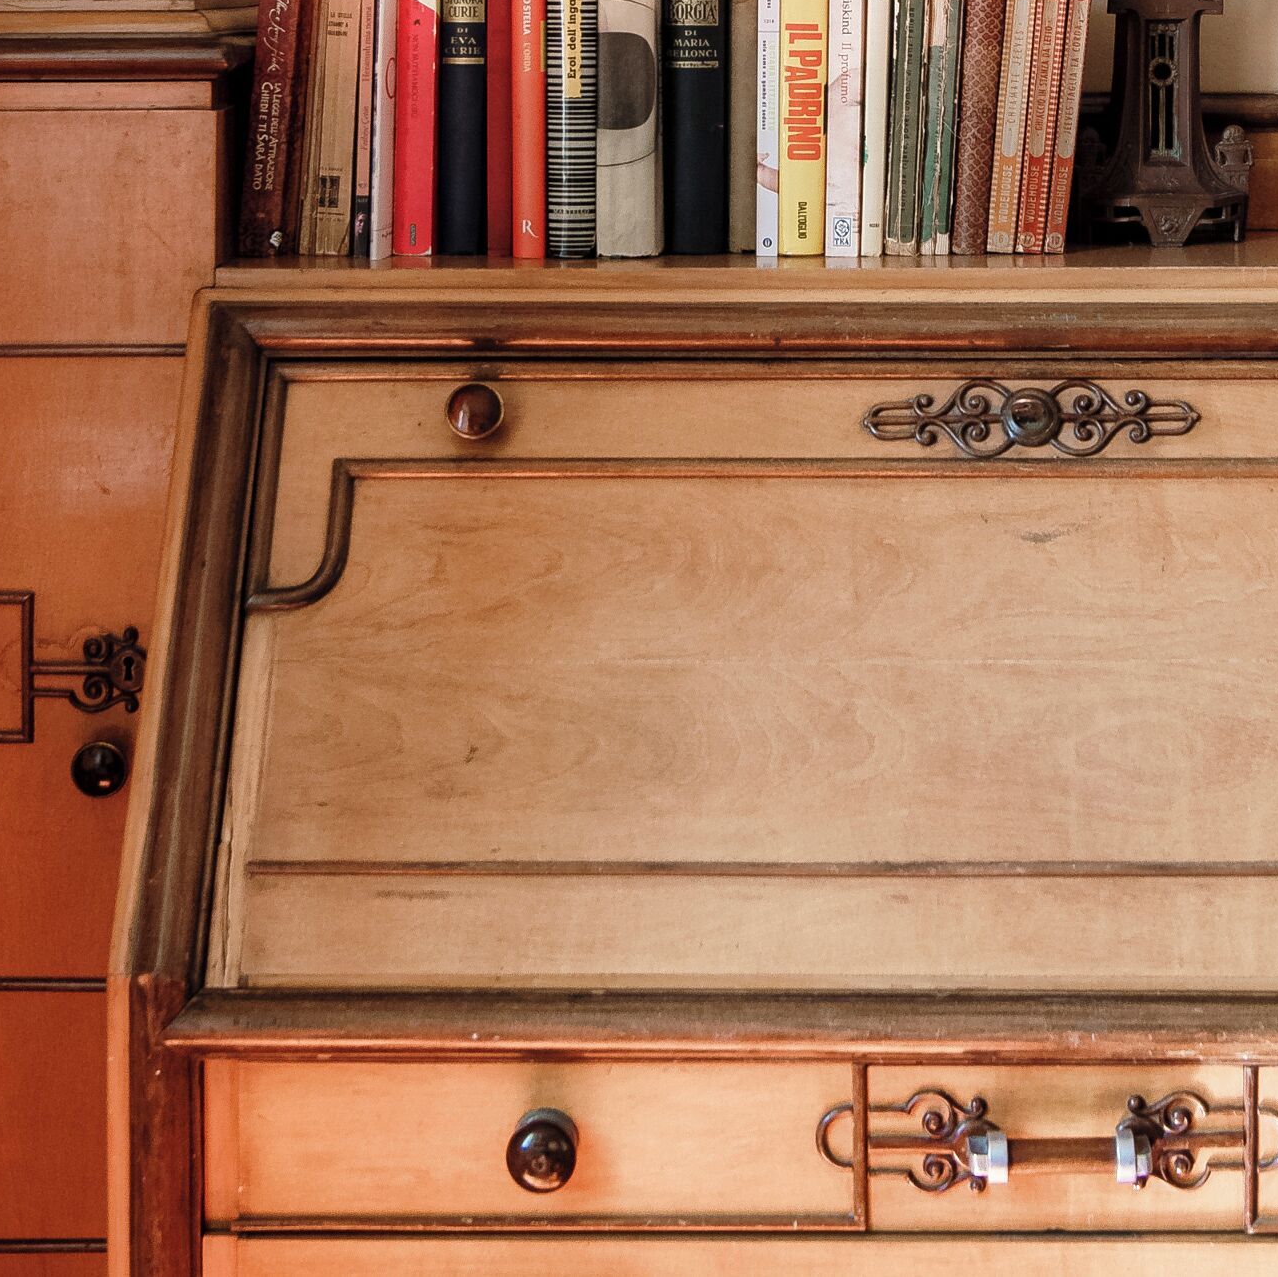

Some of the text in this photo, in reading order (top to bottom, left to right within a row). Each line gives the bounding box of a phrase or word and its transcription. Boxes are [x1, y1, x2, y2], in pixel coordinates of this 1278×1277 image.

[448, 6, 479, 18] CURIE
[523, 5, 532, 35] STELLA
[669, 3, 717, 20] BORGIA
[445, 47, 481, 55] CURIE
[450, 37, 476, 45] EVA
[674, 39, 710, 47] MARIA
[1016, 30, 1024, 67] JEEVES
[1044, 26, 1053, 48] LETTO
[1073, 26, 1083, 56] CORDA
[568, 56, 577, 79] Eroi
[1042, 50, 1050, 63] DA
[838, 54, 850, 104] profumo
[1038, 64, 1048, 91] STANZA
[1067, 72, 1077, 102] TAGLIA
[260, 81, 274, 113] CHIEDI
[784, 23, 822, 161] IL PADRINO
[258, 123, 267, 132] TI
[1034, 98, 1046, 136] GHIACCIO
[1063, 104, 1074, 135] JEEVES
[252, 163, 263, 190] DATO
[1026, 165, 1040, 224] WODEHOUSE
[1051, 166, 1068, 225] WODEHOUSE
